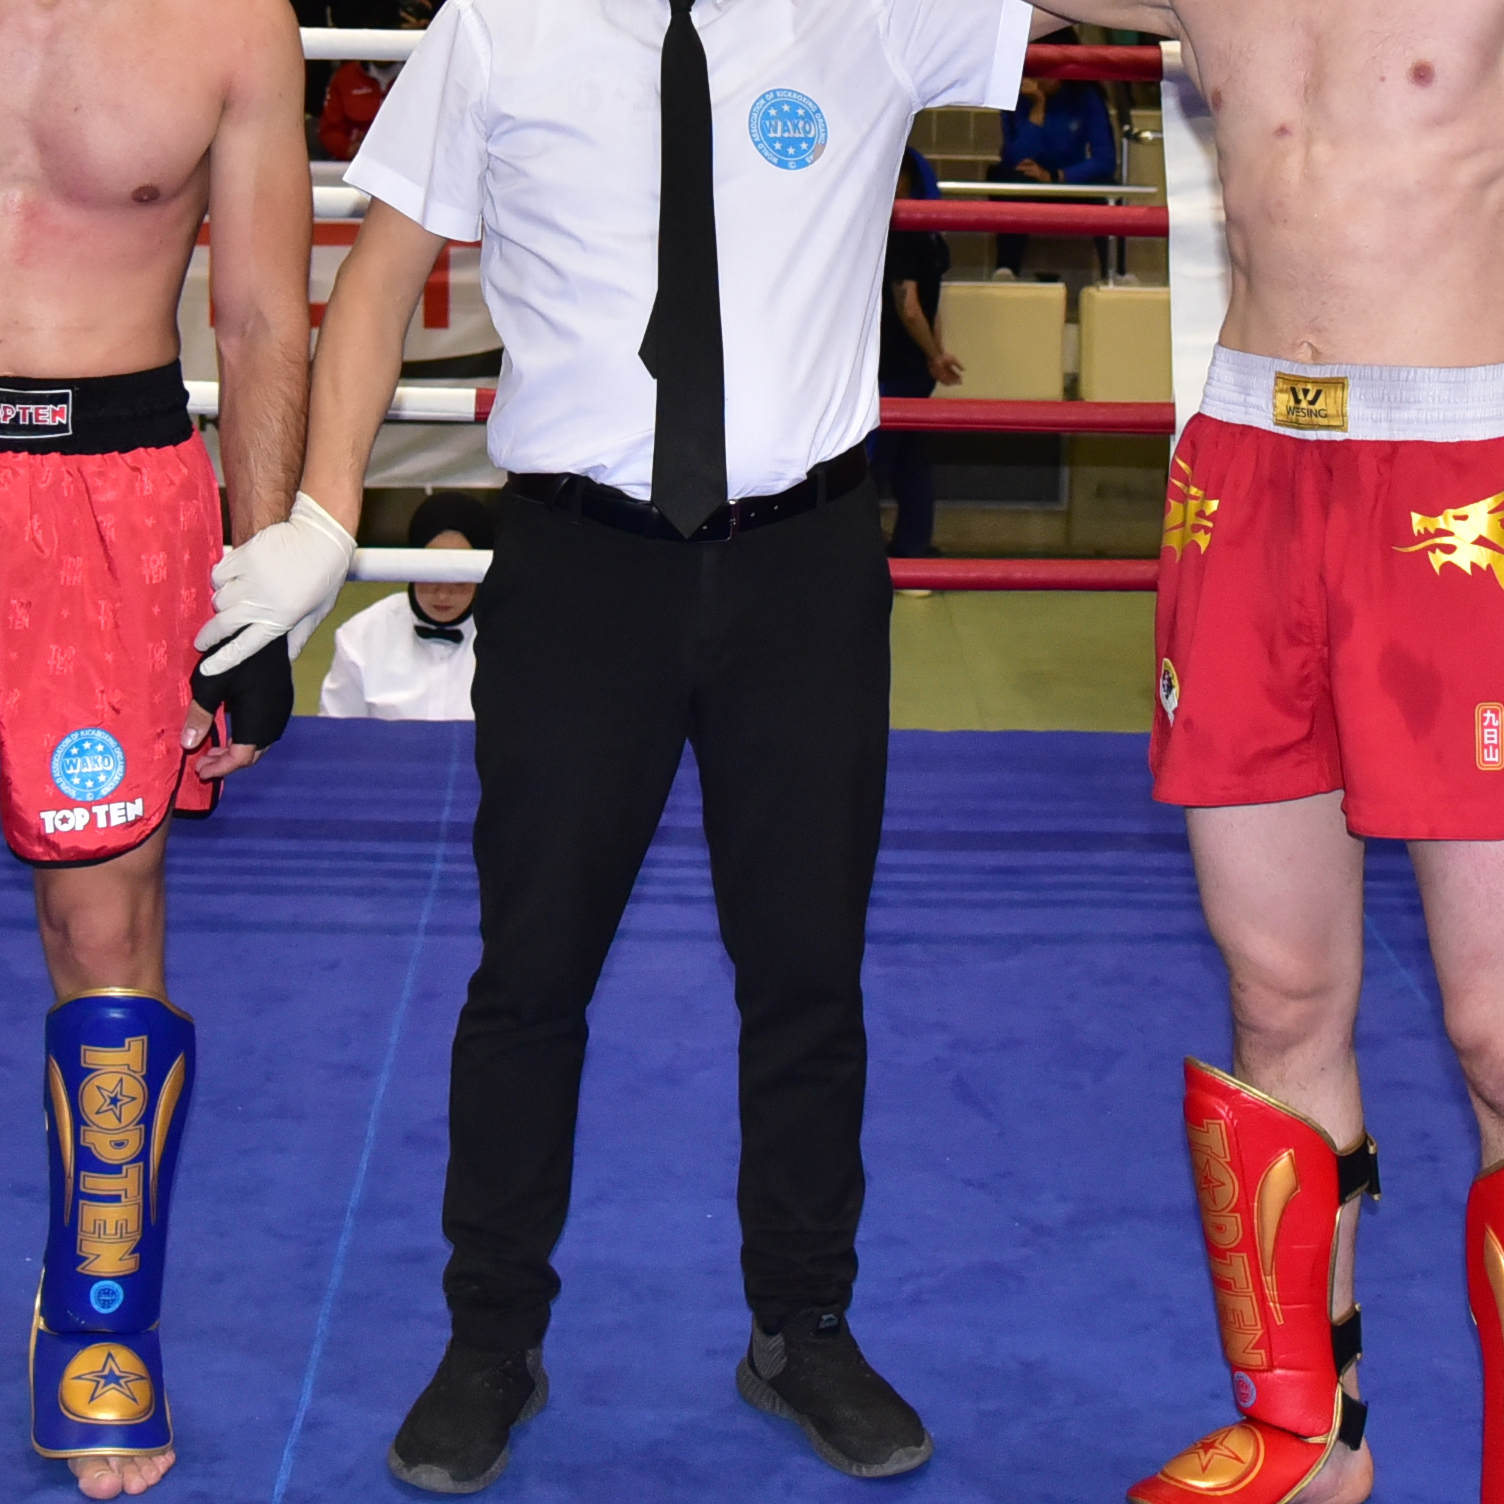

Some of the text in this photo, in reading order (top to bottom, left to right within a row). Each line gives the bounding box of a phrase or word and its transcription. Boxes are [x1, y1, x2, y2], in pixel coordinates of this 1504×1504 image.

[765, 92, 775, 101] OF
[775, 91, 817, 112] KICKBOXING
[750, 98, 766, 142] ASSOCIATION
[761, 118, 816, 138] WAKO
[758, 143, 778, 164] WORLD
[1286, 404, 1328, 419] WESING
[71, 730, 80, 739] OF
[80, 729, 118, 748] KICKBOXING
[1482, 709, 1499, 763] 九日山
[52, 736, 72, 777] ASSOCIATION
[63, 754, 114, 774] WAKO
[56, 777, 77, 799] WORLD
[40, 797, 144, 834] TOP TEN
[79, 1035, 148, 1164] TOP
[1187, 1119, 1244, 1249] TOP
[76, 1161, 144, 1278] TEN
[1209, 1251, 1267, 1371] TEN
